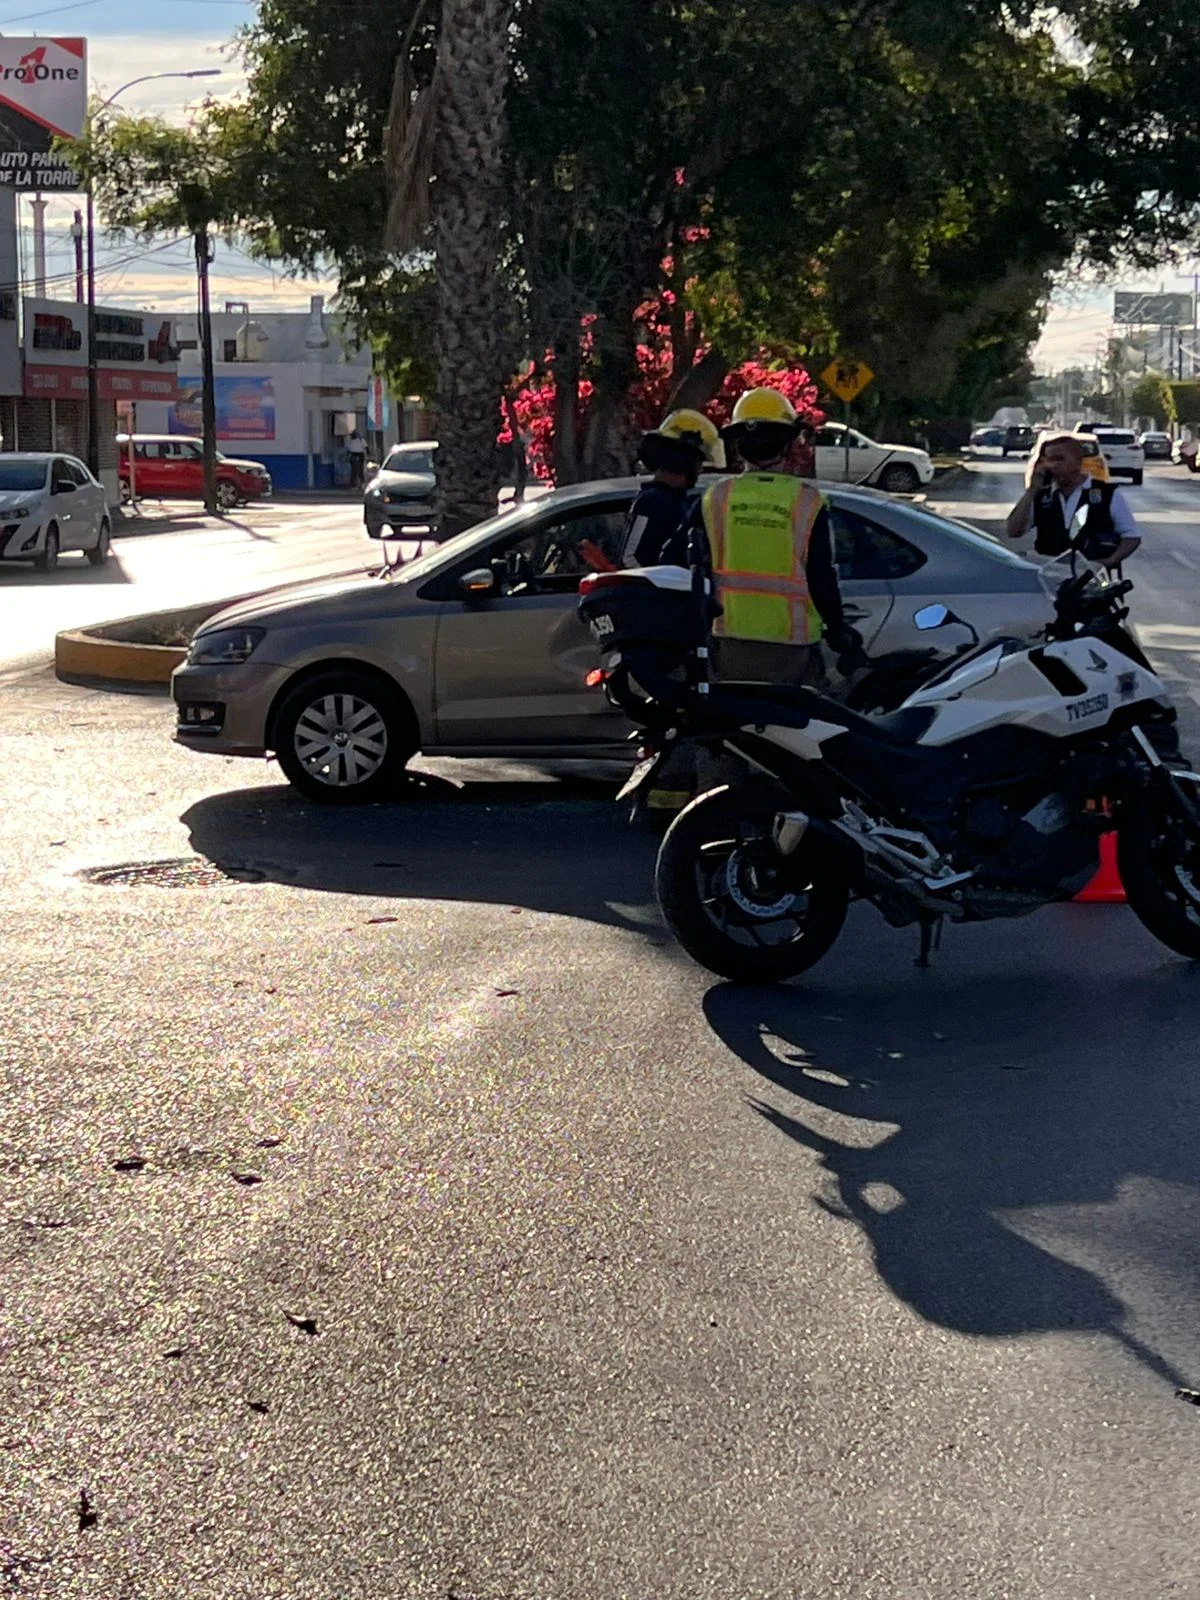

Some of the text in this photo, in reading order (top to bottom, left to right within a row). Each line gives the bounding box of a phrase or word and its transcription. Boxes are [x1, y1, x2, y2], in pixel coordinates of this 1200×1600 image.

[0, 152, 28, 167] UTO
[15, 170, 32, 185] LA
[36, 170, 80, 185] TORRE
